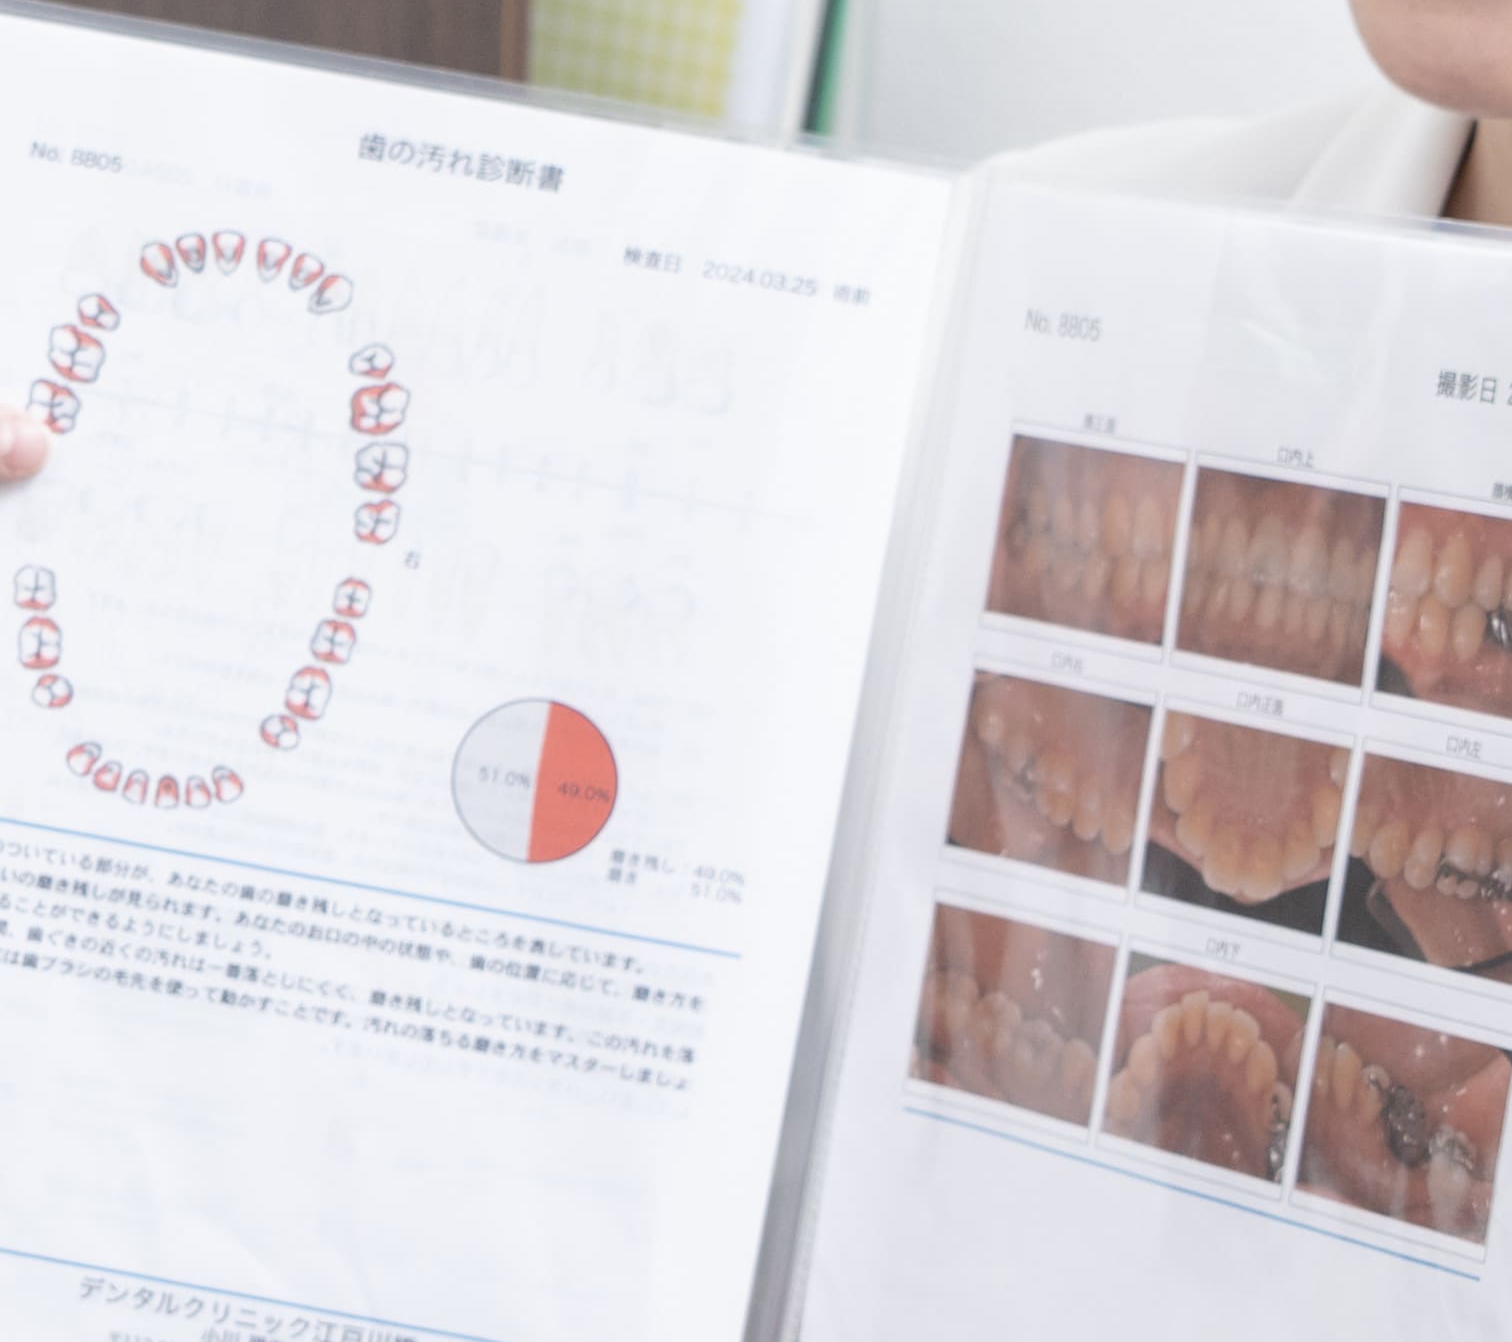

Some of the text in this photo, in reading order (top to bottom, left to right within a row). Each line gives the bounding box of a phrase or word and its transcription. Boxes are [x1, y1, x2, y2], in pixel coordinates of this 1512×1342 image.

[357, 130, 567, 195] 歯の汚れ診断書
[623, 244, 684, 275] 検査日
[702, 259, 818, 299] 2024.03.25
[1057, 312, 1102, 343] 8805
[1436, 368, 1498, 406] 撮影日
